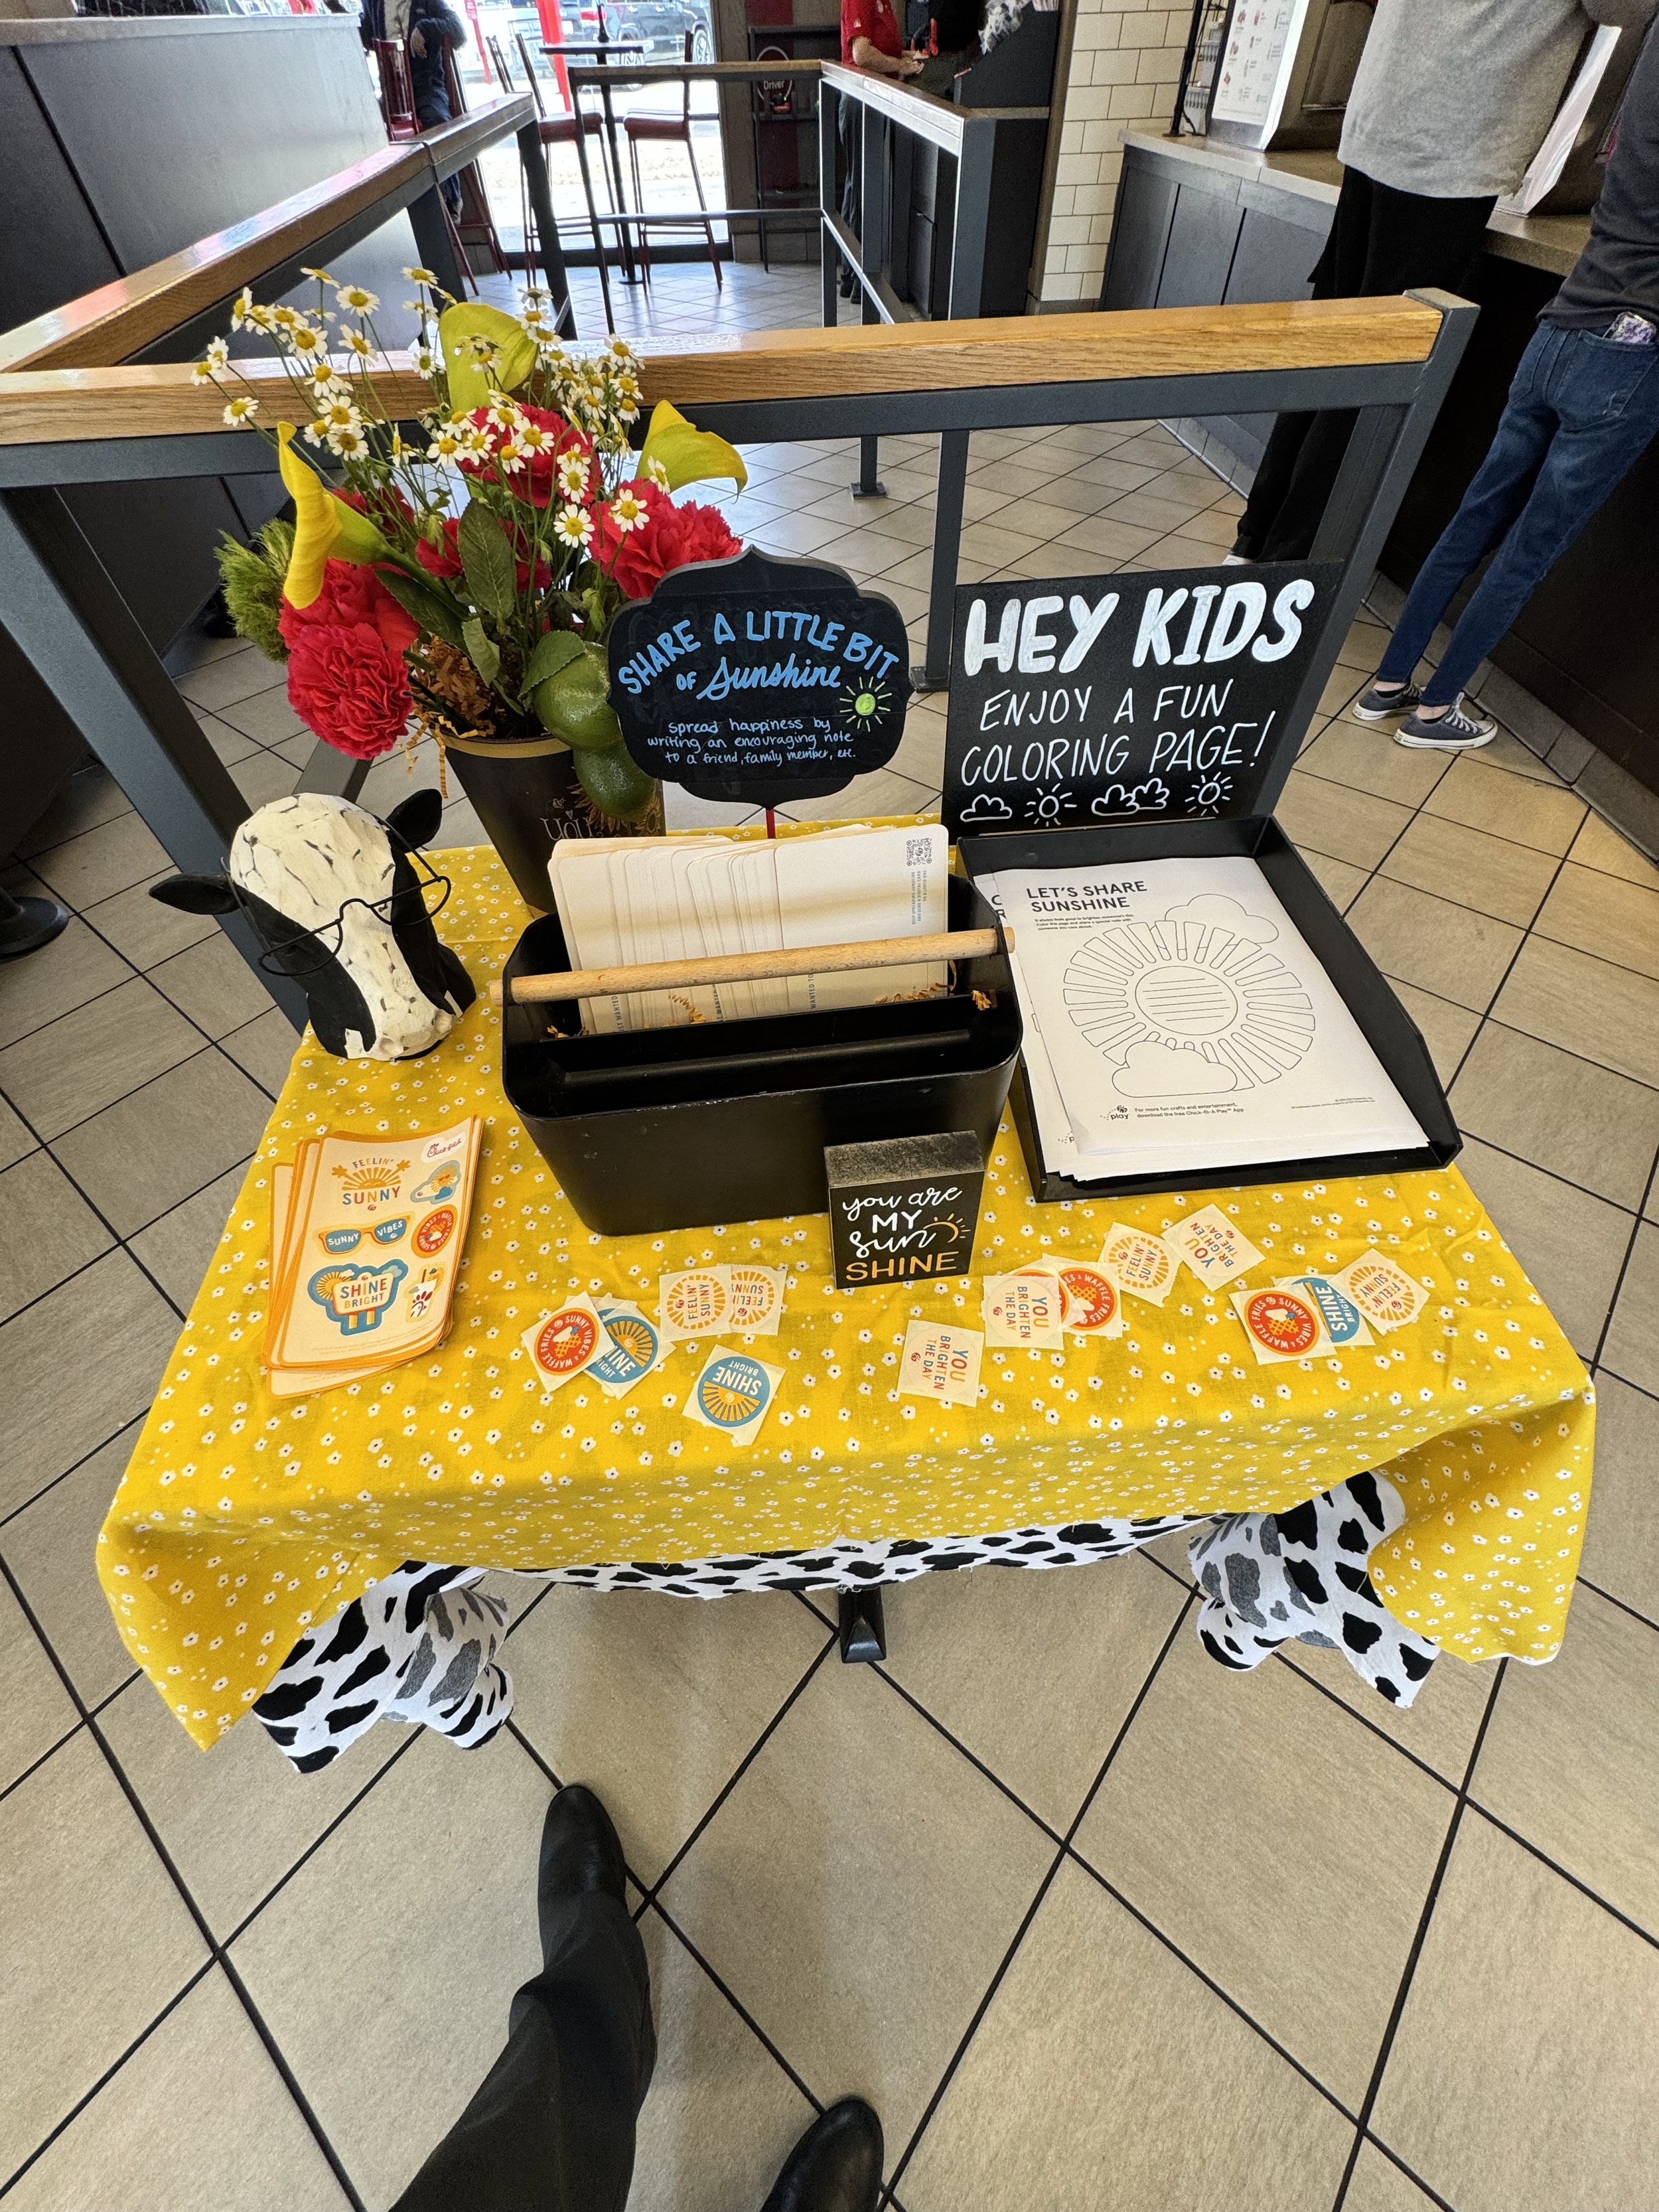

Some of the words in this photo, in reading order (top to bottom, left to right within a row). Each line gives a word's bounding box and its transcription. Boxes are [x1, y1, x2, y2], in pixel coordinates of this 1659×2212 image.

[763, 80, 785, 90] Driver
[964, 593, 1120, 676] HEY
[1132, 579, 1315, 668] KIDS
[618, 620, 701, 694] SHARE
[714, 613, 736, 644] A
[747, 611, 845, 651] LITTLE
[843, 632, 900, 679] BIT
[697, 654, 841, 700] Sunshine
[979, 686, 1092, 731] ENJOY
[1114, 688, 1134, 724] A
[1153, 678, 1234, 722] FUN
[668, 721, 719, 734] spread
[730, 718, 804, 733] happiness
[814, 717, 831, 733] by
[647, 737, 701, 755] writing
[707, 738, 727, 748] an
[735, 733, 817, 750] encouraging
[824, 731, 854, 743] note
[961, 735, 1129, 786] COLORING
[1149, 711, 1276, 774] PAGE!
[665, 752, 680, 764] to
[686, 753, 697, 765] a
[787, 749, 833, 762] member,
[837, 749, 856, 759] etc.
[1027, 887, 1078, 899] LET'S
[1084, 881, 1148, 896] SHARE
[1031, 897, 1130, 913] SUNSHINE
[808, 974, 814, 982] TO
[611, 995, 622, 1021] WANTED
[352, 1157, 394, 1169] FEELIN'
[342, 1186, 401, 1205] SUNNY
[842, 1196, 902, 1221] you
[908, 1187, 963, 1206] are
[327, 1232, 359, 1246] SUNNY
[376, 1219, 403, 1238] VIBES
[872, 1209, 922, 1234] MY
[1204, 1224, 1224, 1240] DAY
[1185, 1238, 1216, 1268] YOU
[1190, 1222, 1234, 1268] BRIGHTEN
[1220, 1240, 1238, 1258] THE
[845, 1251, 959, 1281] SHINE
[1126, 1243, 1145, 1277] FEELIN'
[1139, 1249, 1157, 1281] SUNNY
[340, 1278, 388, 1298] SHINE
[1084, 1274, 1111, 1301] WAFFLE
[1360, 1274, 1388, 1298] SUNNY
[1372, 1282, 1402, 1307] FEELIN'
[344, 1293, 384, 1309] BRIGHT
[687, 1284, 697, 1319] FEELIN'
[699, 1284, 711, 1317] SUNNY
[1005, 1291, 1015, 1308] THE
[1252, 1300, 1267, 1321] FRIES
[1279, 1297, 1309, 1320] SUNNY
[1315, 1286, 1348, 1331] SHINE
[565, 1315, 590, 1329] SUNNY
[1005, 1312, 1017, 1331] DAY
[1017, 1286, 1031, 1339] BRIGHTEN
[1031, 1297, 1050, 1328] YOU
[1090, 1302, 1111, 1323] FRIES
[541, 1328, 555, 1353] FRIES
[578, 1329, 593, 1356] VIBES
[1254, 1323, 1289, 1349] WAFFLE
[1295, 1323, 1312, 1346] VIBES
[542, 1353, 573, 1368] WAFFLE
[925, 1339, 937, 1357] THE
[595, 1358, 616, 1378] RIGHT
[728, 1359, 758, 1376] BRIGHT
[922, 1360, 934, 1380] DAY
[934, 1335, 951, 1390] BRIGHTEN
[950, 1350, 969, 1382] YOU
[712, 1366, 762, 1396] SHINE
